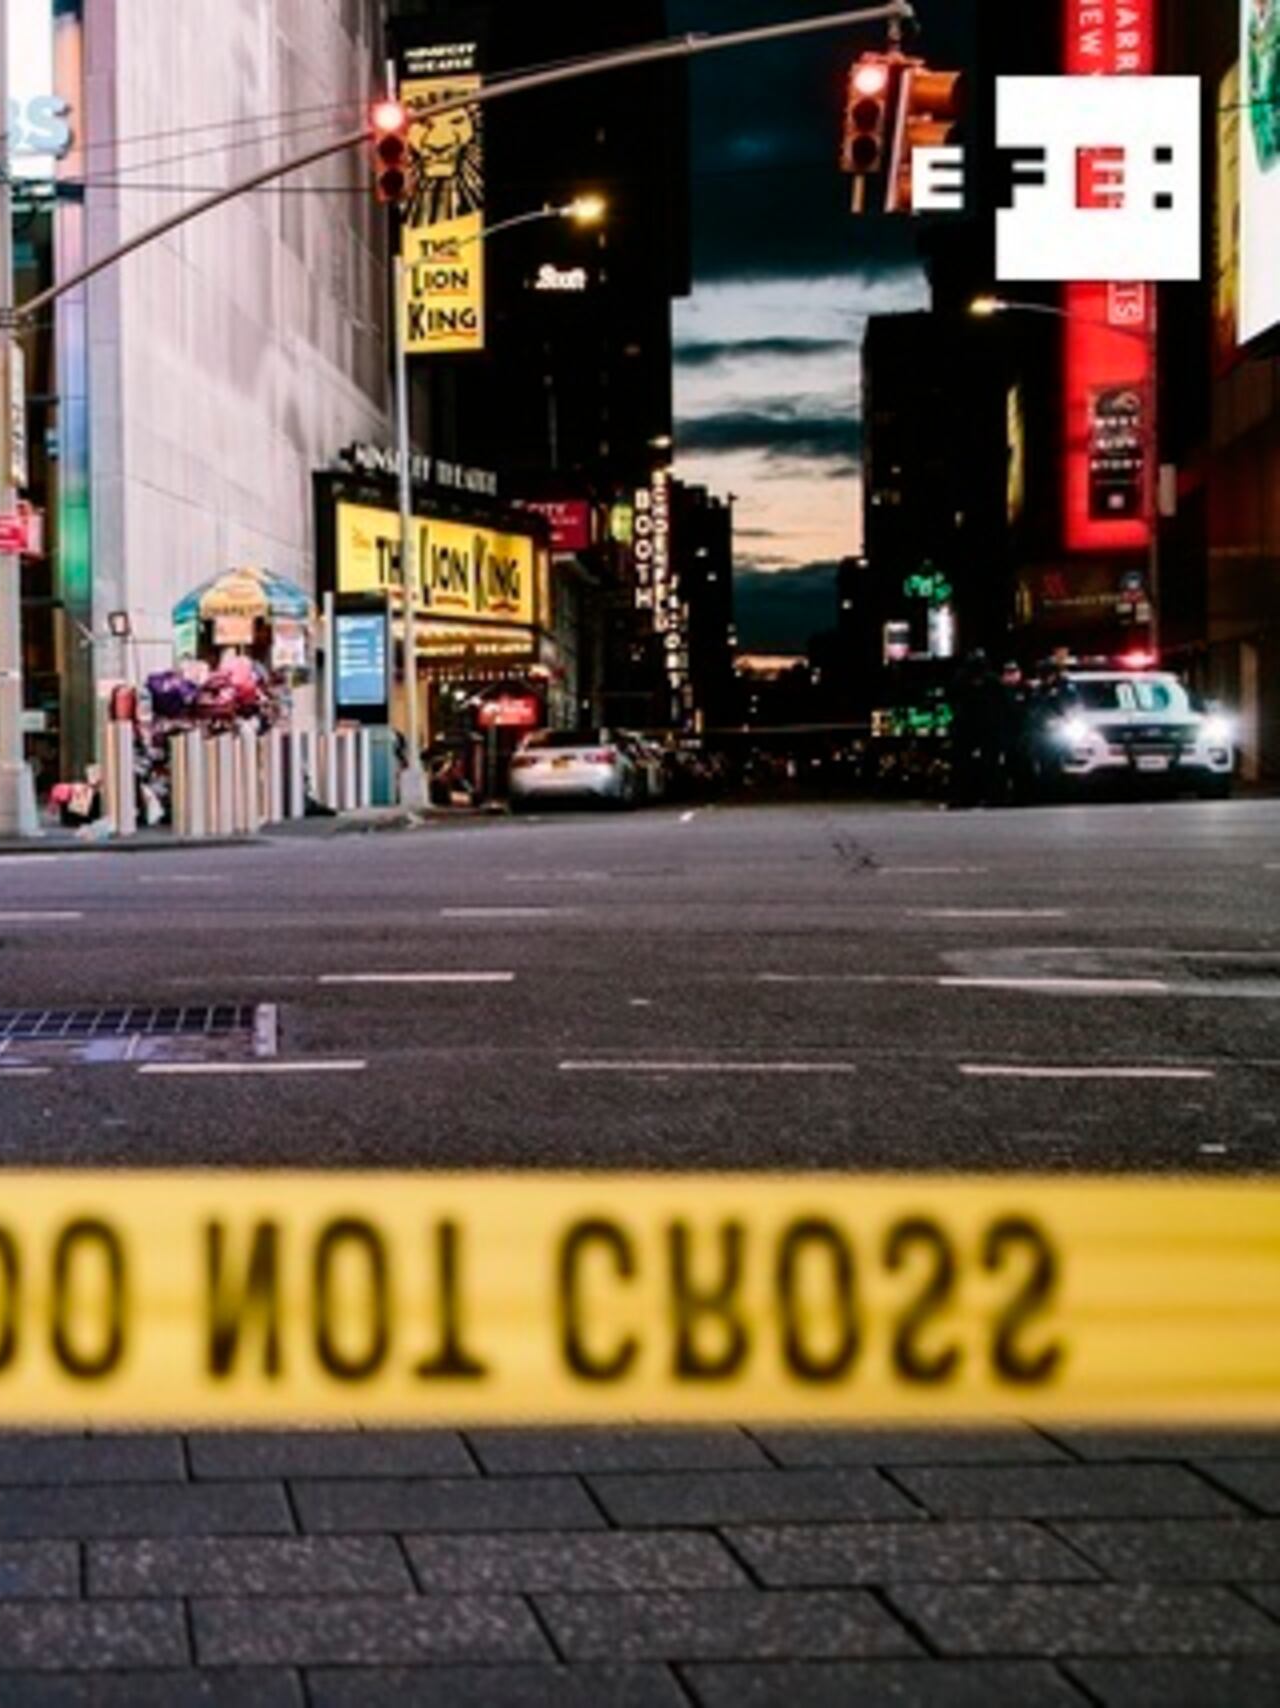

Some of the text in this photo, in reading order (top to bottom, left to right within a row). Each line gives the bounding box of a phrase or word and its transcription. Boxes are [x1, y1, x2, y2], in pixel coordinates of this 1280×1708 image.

[418, 236, 461, 258] THE
[410, 265, 469, 298] LION
[408, 302, 478, 341] KING
[634, 487, 652, 610] BOOTH
[419, 525, 471, 608] LION
[473, 531, 522, 613] KING
